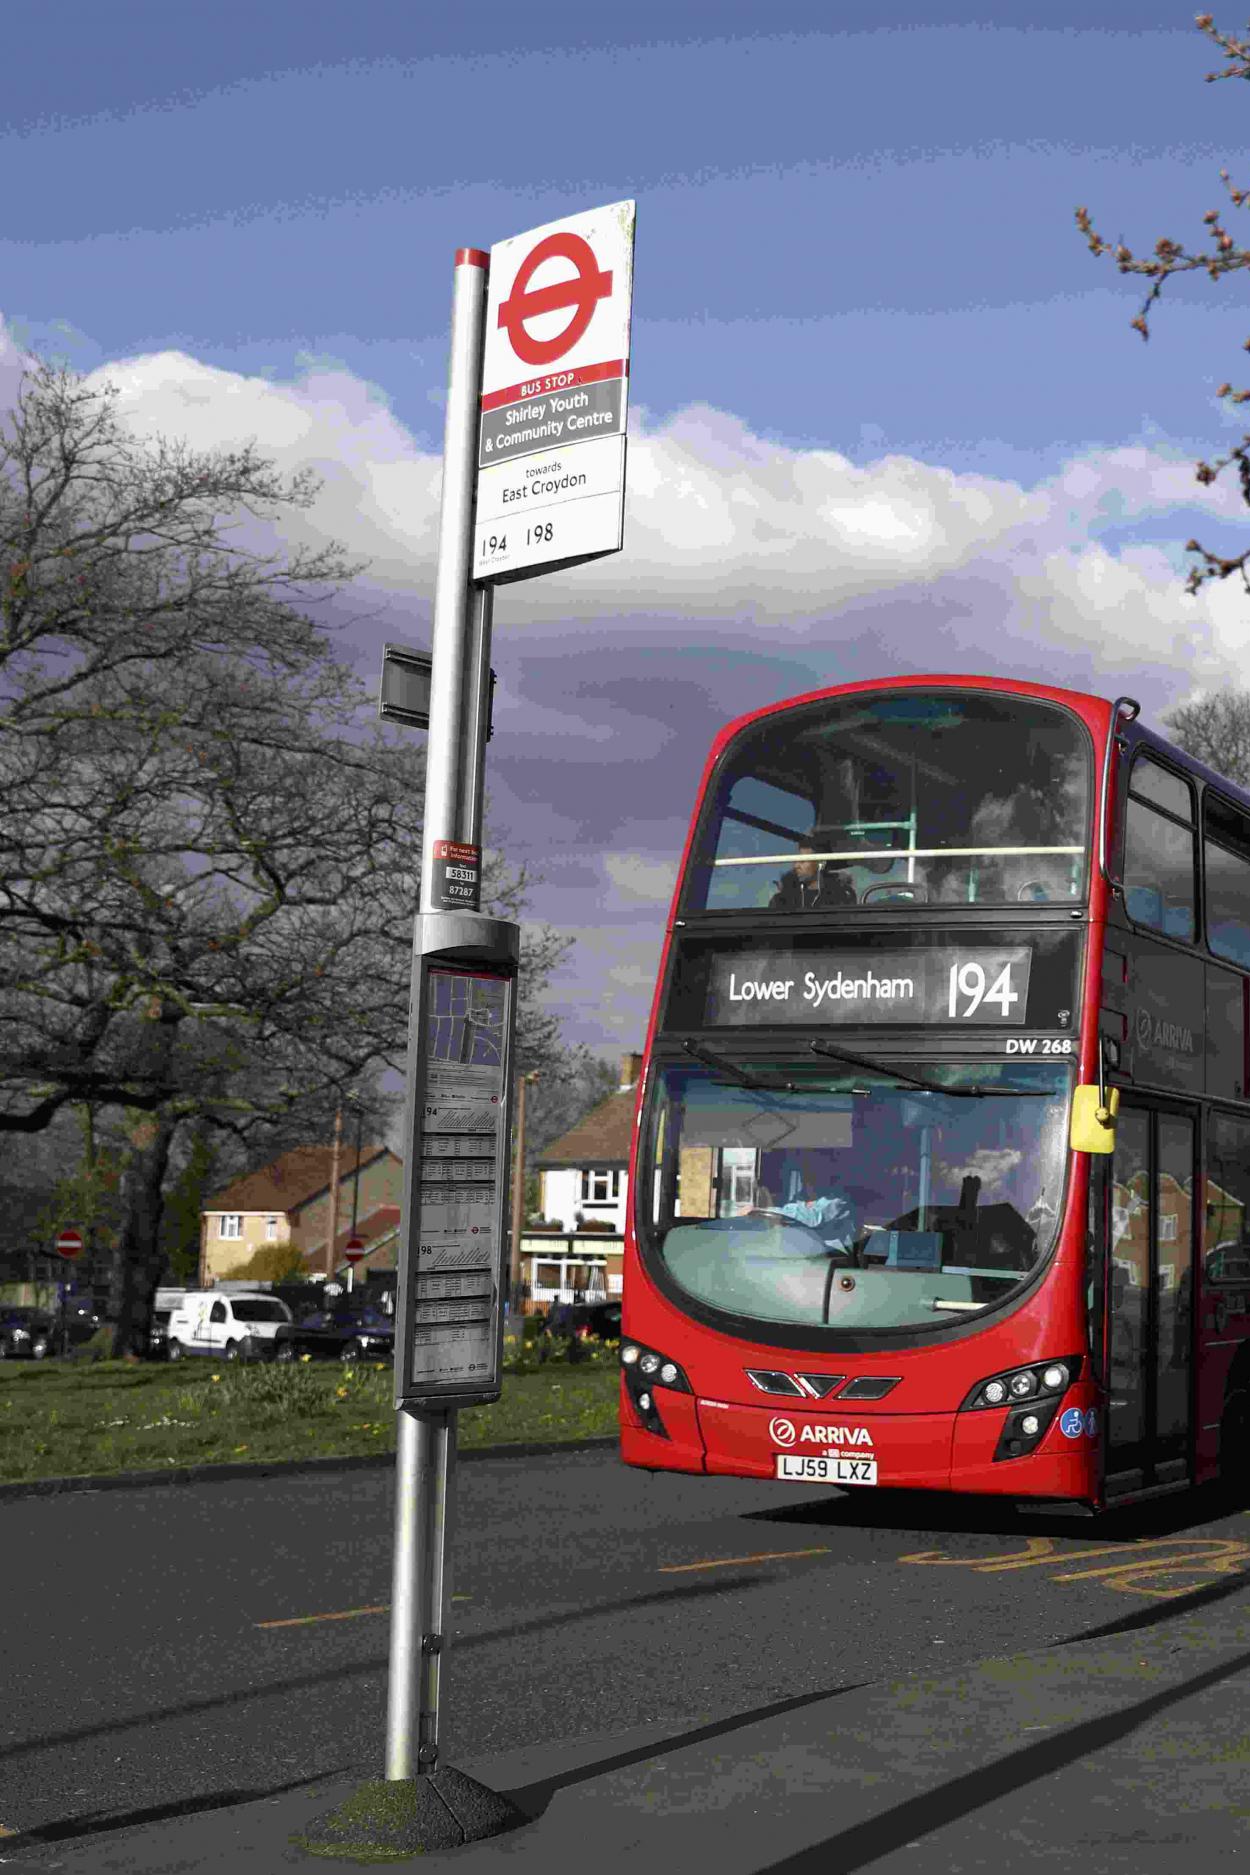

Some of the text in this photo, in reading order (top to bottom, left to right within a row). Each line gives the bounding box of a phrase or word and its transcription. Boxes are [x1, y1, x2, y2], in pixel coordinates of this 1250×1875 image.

[521, 373, 574, 396] BUS STOP
[505, 392, 589, 425] Shirley Youth
[485, 411, 613, 452] & Community Centre
[526, 462, 562, 478] towards
[502, 474, 586, 503] East Croydon
[482, 523, 553, 557] 194 198
[451, 869, 474, 880] 58311
[449, 885, 474, 897] 87287
[729, 962, 1018, 1018] Lower Sydenham 194
[1006, 1039, 1072, 1054] DW 268
[1153, 1019, 1194, 1052] ARRIVA
[800, 1425, 874, 1446] ARRIVA
[841, 1451, 874, 1460] company
[783, 1458, 871, 1480] LJ59 LXZ
